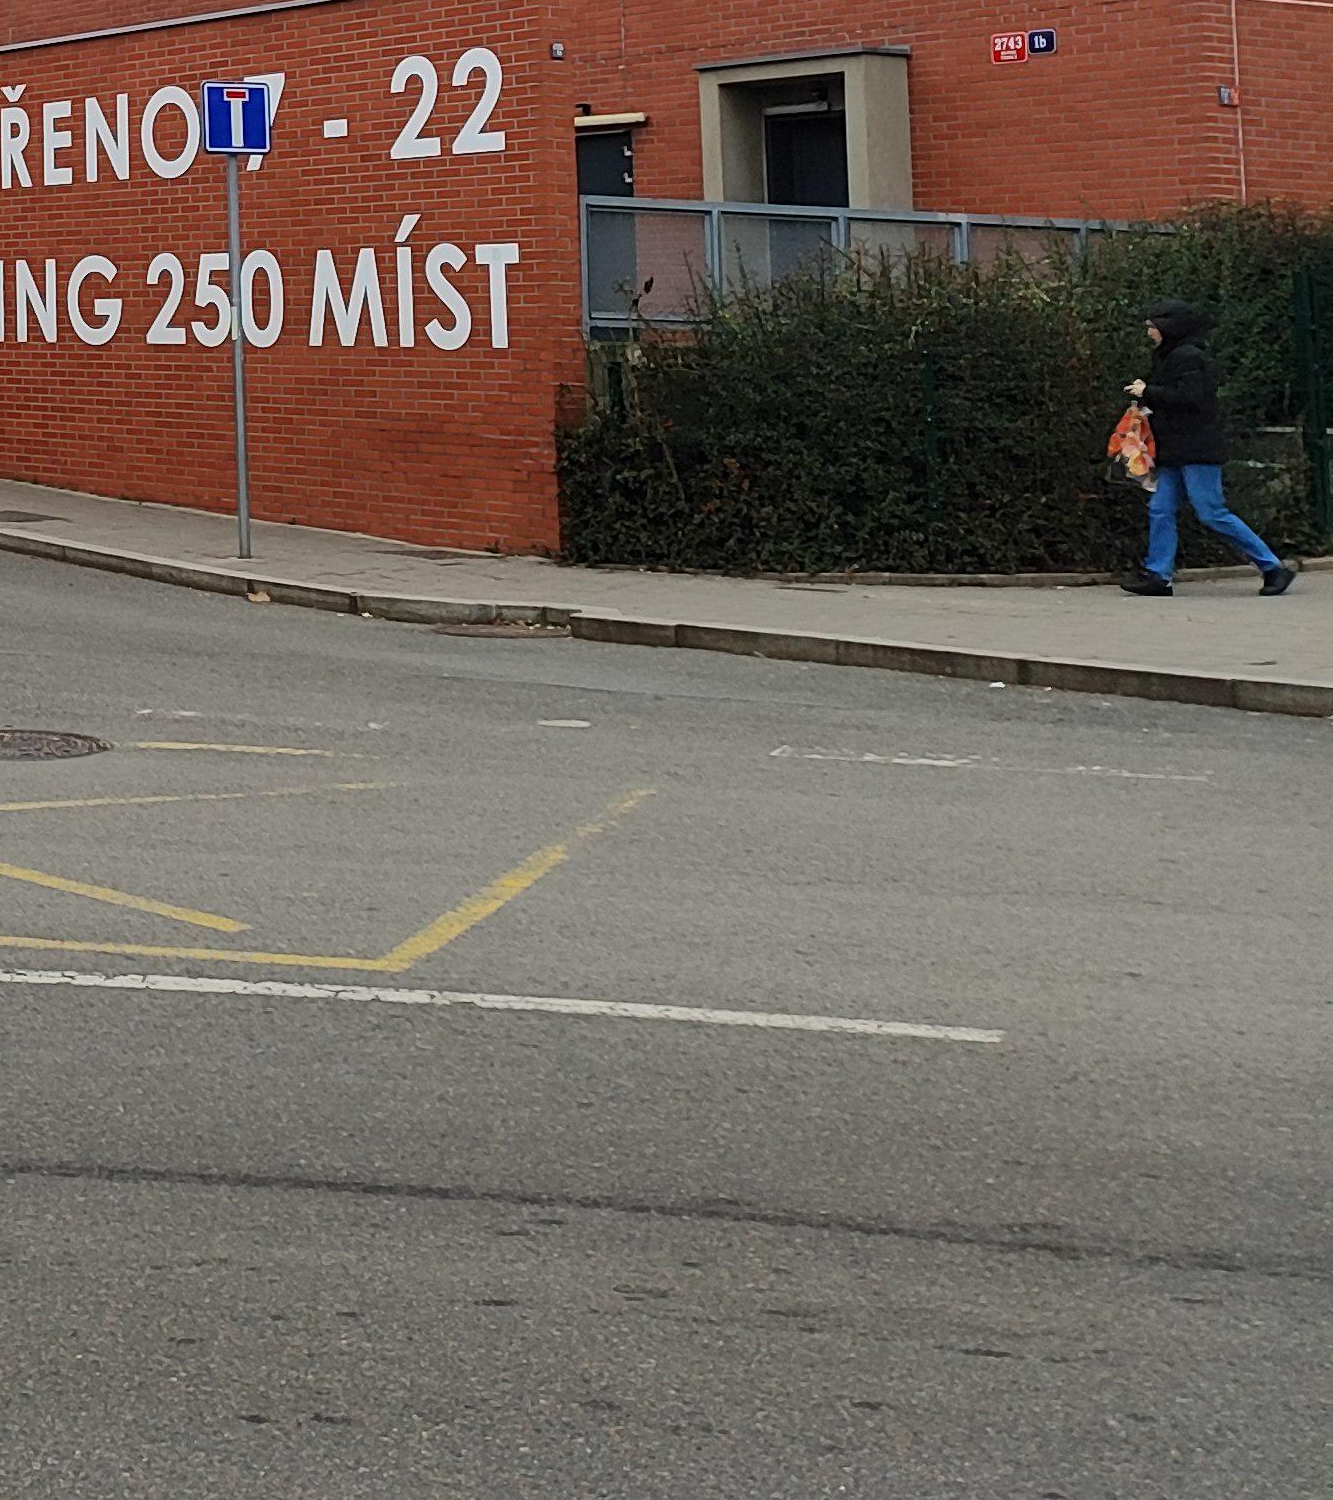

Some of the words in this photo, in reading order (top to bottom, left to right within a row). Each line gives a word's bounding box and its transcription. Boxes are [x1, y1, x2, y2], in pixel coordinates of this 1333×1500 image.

[994, 36, 1023, 51] 2743
[1033, 34, 1047, 49] 1b
[390, 47, 506, 160] 22
[145, 252, 284, 348] 250
[308, 212, 521, 351] MÍST
